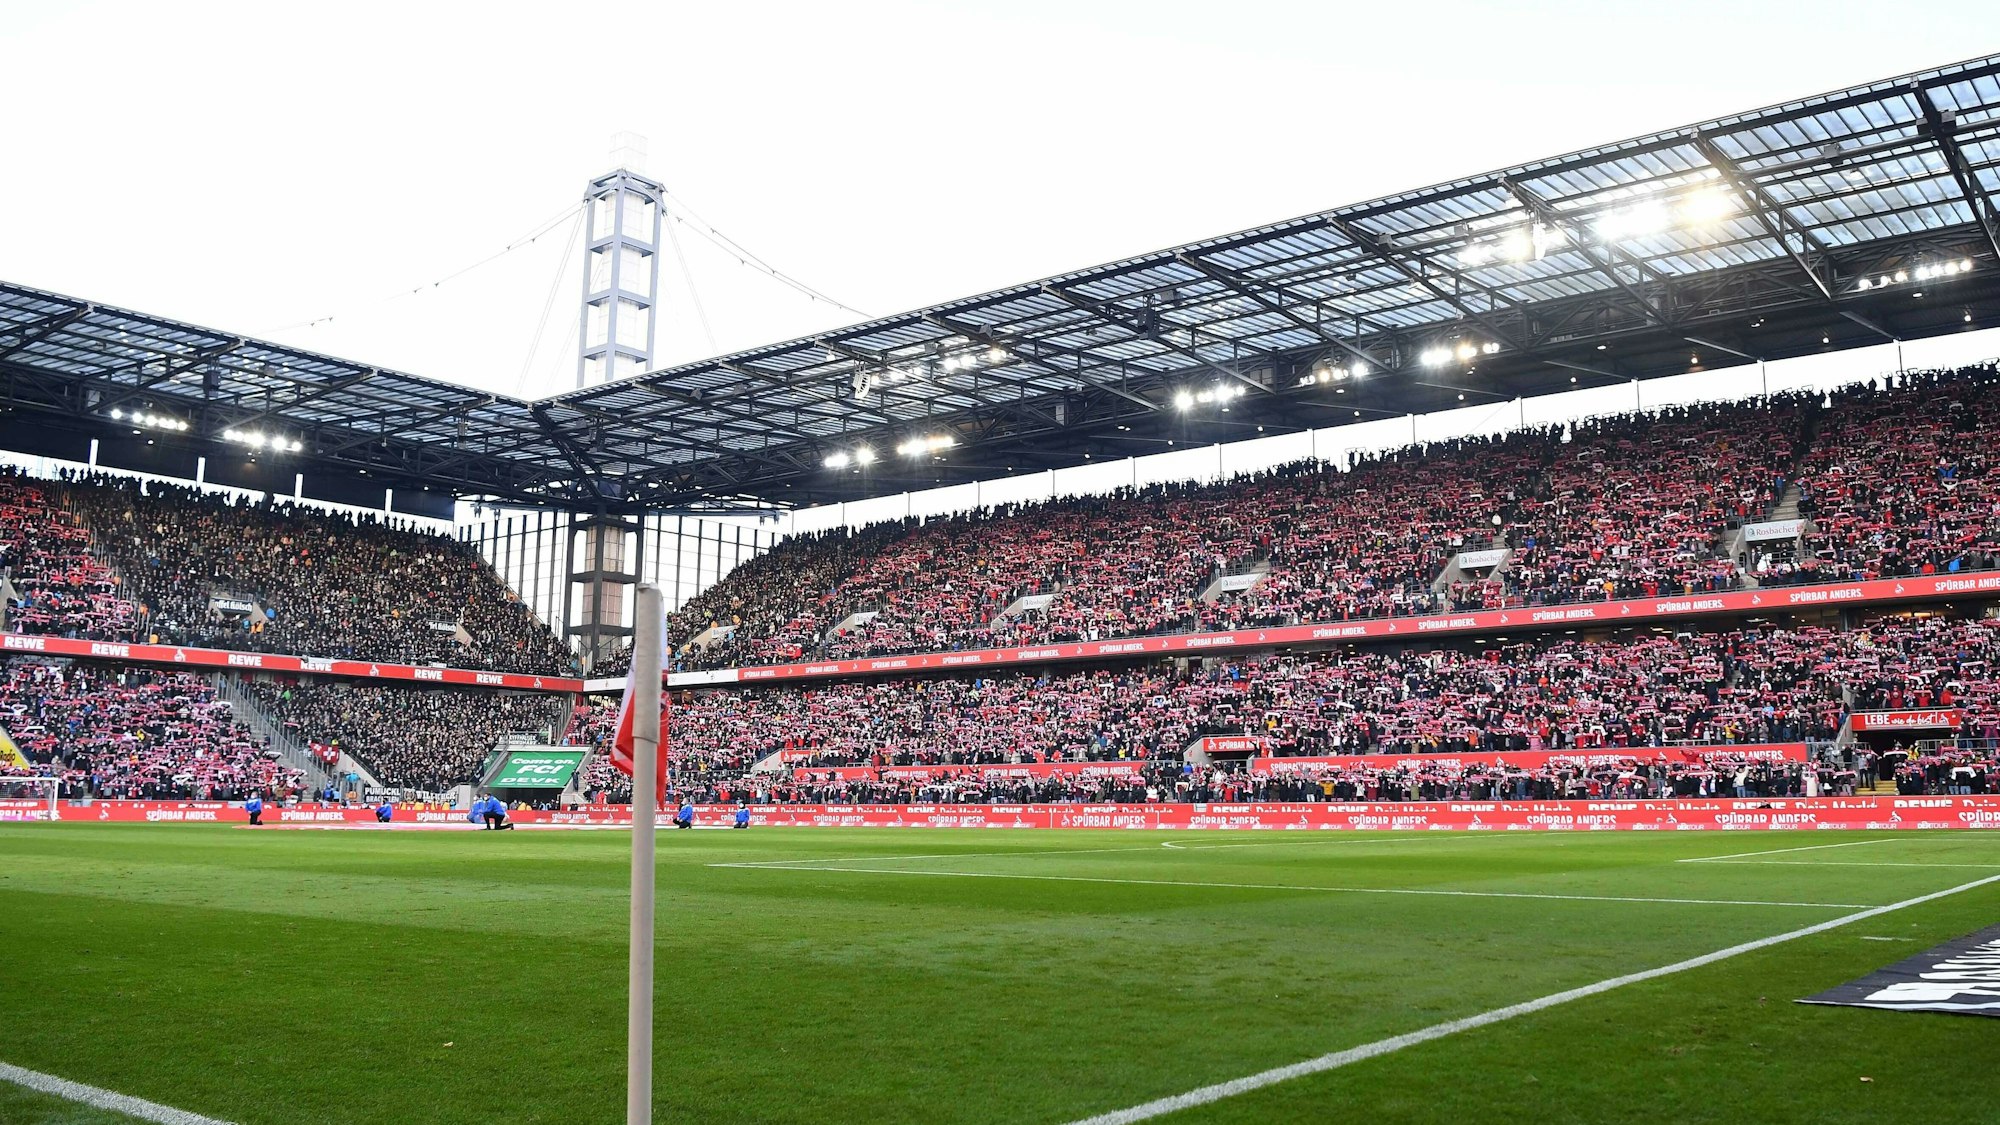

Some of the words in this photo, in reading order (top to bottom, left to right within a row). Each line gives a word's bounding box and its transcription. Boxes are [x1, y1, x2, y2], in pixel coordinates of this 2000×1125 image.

[1756, 526, 1795, 536] Rosbacher
[1934, 579, 1976, 592] SPÜRBAR
[1790, 591, 1828, 603] SPÜRBAR
[1829, 588, 1864, 599] ANDERS.
[1656, 601, 1692, 613] SPÜRBAR
[1692, 599, 1725, 610] ANDERS.
[1532, 611, 1565, 621] SPÜRBAR
[1565, 608, 1596, 619] ANDERS.
[1418, 619, 1448, 630] SPÜRBAR
[1449, 617, 1477, 628] ANDERS.
[1313, 629, 1341, 638] SPÜRBAR
[1341, 627, 1367, 636] ANDERS.
[4, 636, 46, 650] REWE
[1186, 637, 1212, 647] SPÜRBAR
[1212, 636, 1236, 645] ANDERS.
[91, 643, 130, 657] REWE
[1018, 650, 1040, 659] SPÜRBAR
[1099, 644, 1123, 653] SPÜRBAR
[227, 654, 263, 667] REWE
[414, 669, 443, 680] REWE
[476, 674, 504, 685] REWE
[1865, 714, 1890, 725] LEBE
[1218, 740, 1245, 750] SPÜRBAR
[516, 765, 565, 774] FC!
[365, 787, 401, 796] PUMUCKL
[146, 808, 184, 821] SPÜRBAR
[184, 810, 218, 821] ANDERS.
[281, 809, 315, 821] SPÜRBAR
[315, 810, 345, 821] ANDERS.
[416, 810, 446, 822] SPÜRBAR
[1072, 813, 1111, 828] SPÜRBAR
